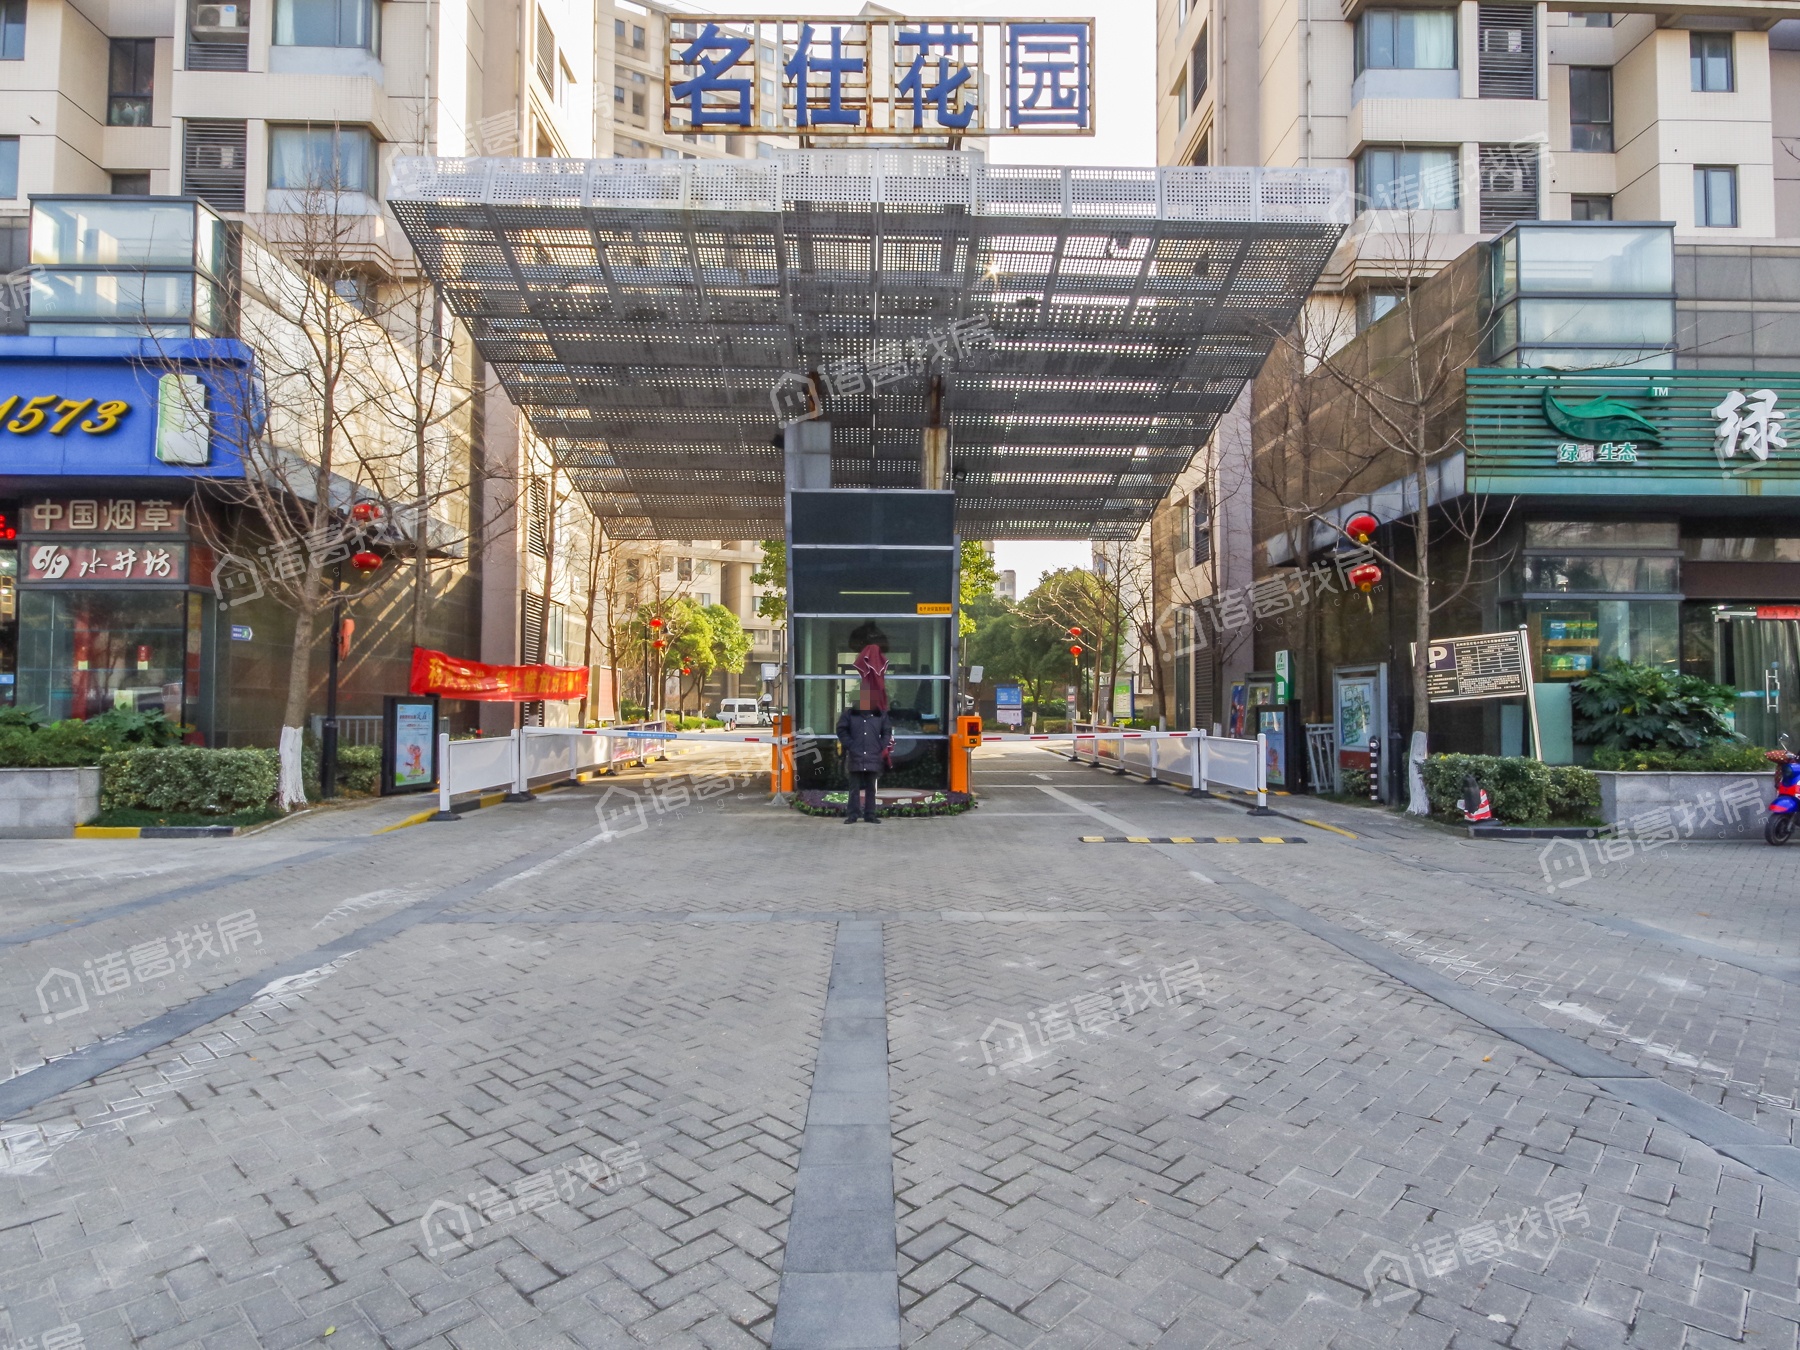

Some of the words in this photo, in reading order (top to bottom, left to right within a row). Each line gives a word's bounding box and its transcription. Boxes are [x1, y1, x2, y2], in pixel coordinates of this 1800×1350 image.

[672, 22, 1088, 129] 名仕花园
[1652, 387, 1669, 396] TM
[1711, 389, 1788, 460] 绿
[34, 498, 172, 531] 中国烟草
[79, 548, 171, 578] 水井坊
[1428, 646, 1448, 669] P
